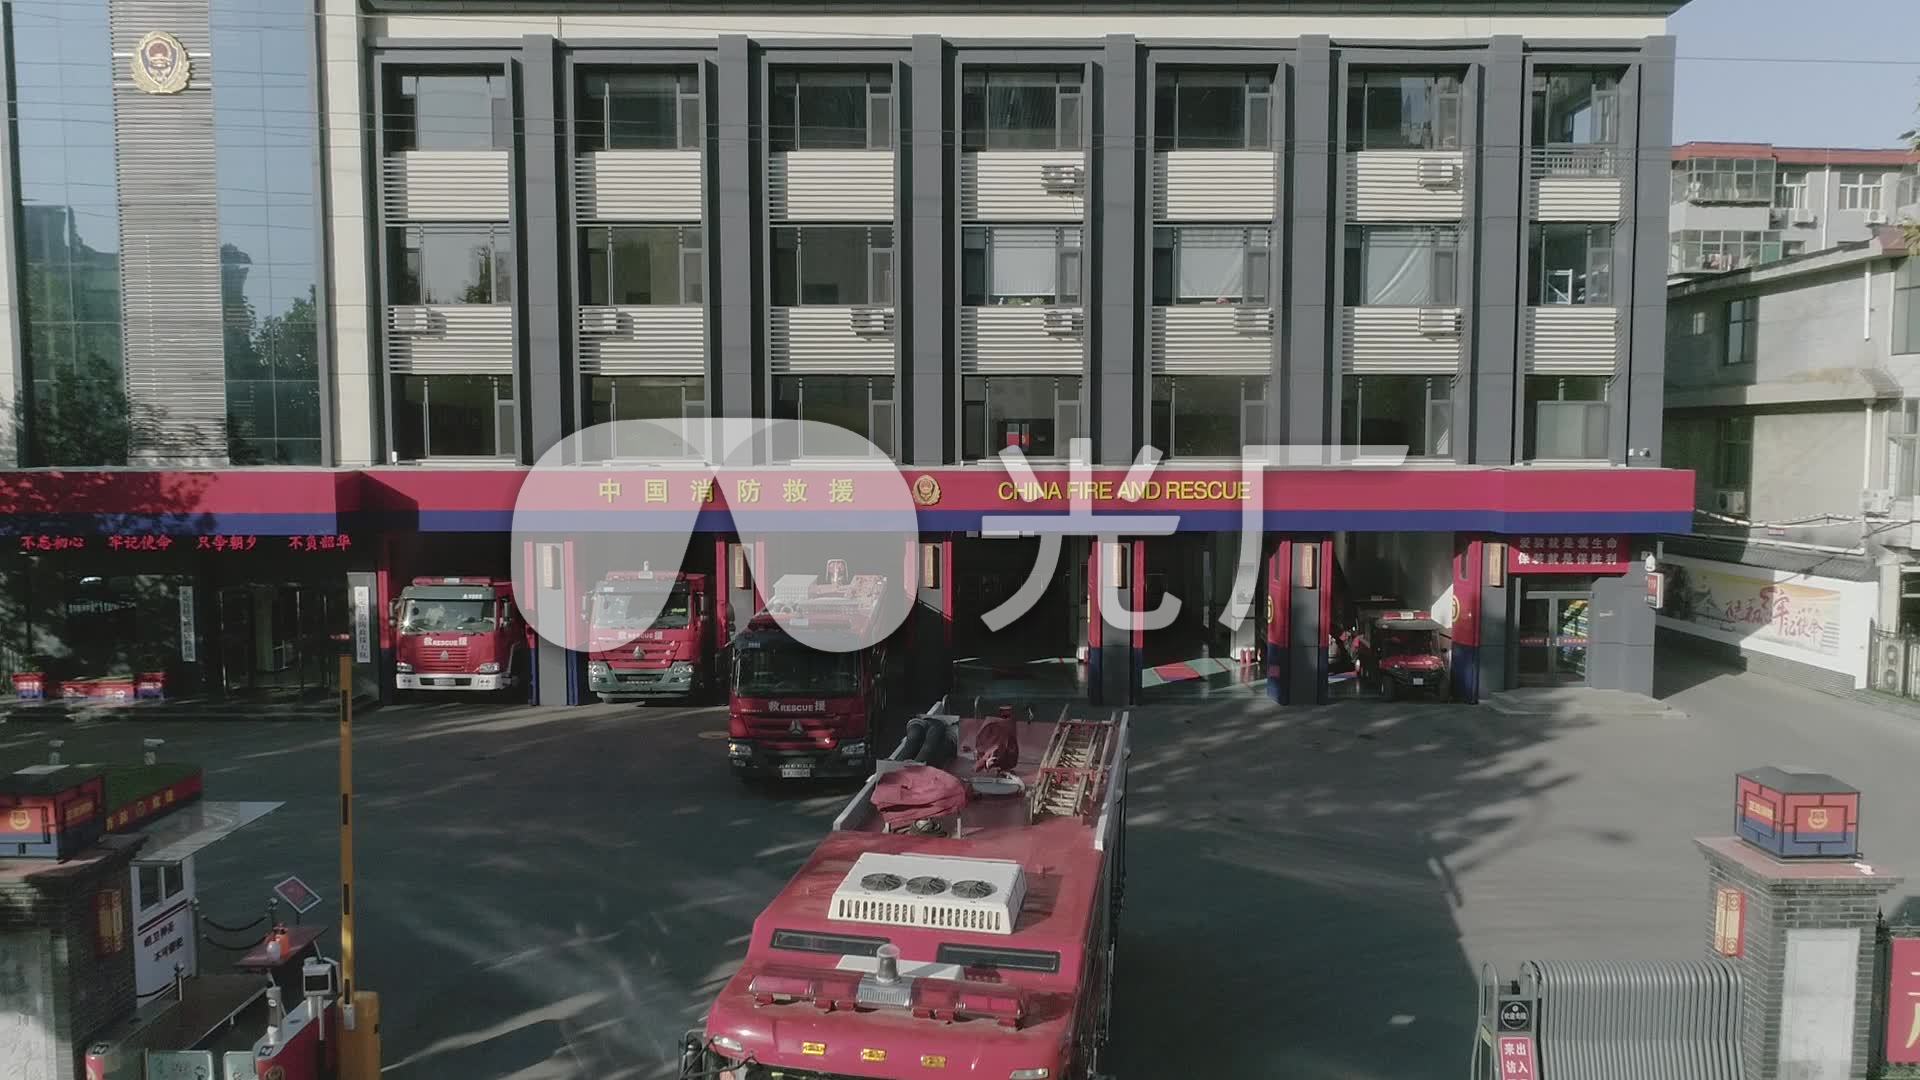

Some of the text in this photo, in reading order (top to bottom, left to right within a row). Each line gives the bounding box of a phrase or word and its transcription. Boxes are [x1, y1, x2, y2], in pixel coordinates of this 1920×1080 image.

[599, 478, 855, 503] 中国消防救援
[998, 481, 1252, 500] CHINA FIRE AND RESCUE
[20, 535, 352, 551] 不忘初心 牢记使命 只争朝夕 不负韶华
